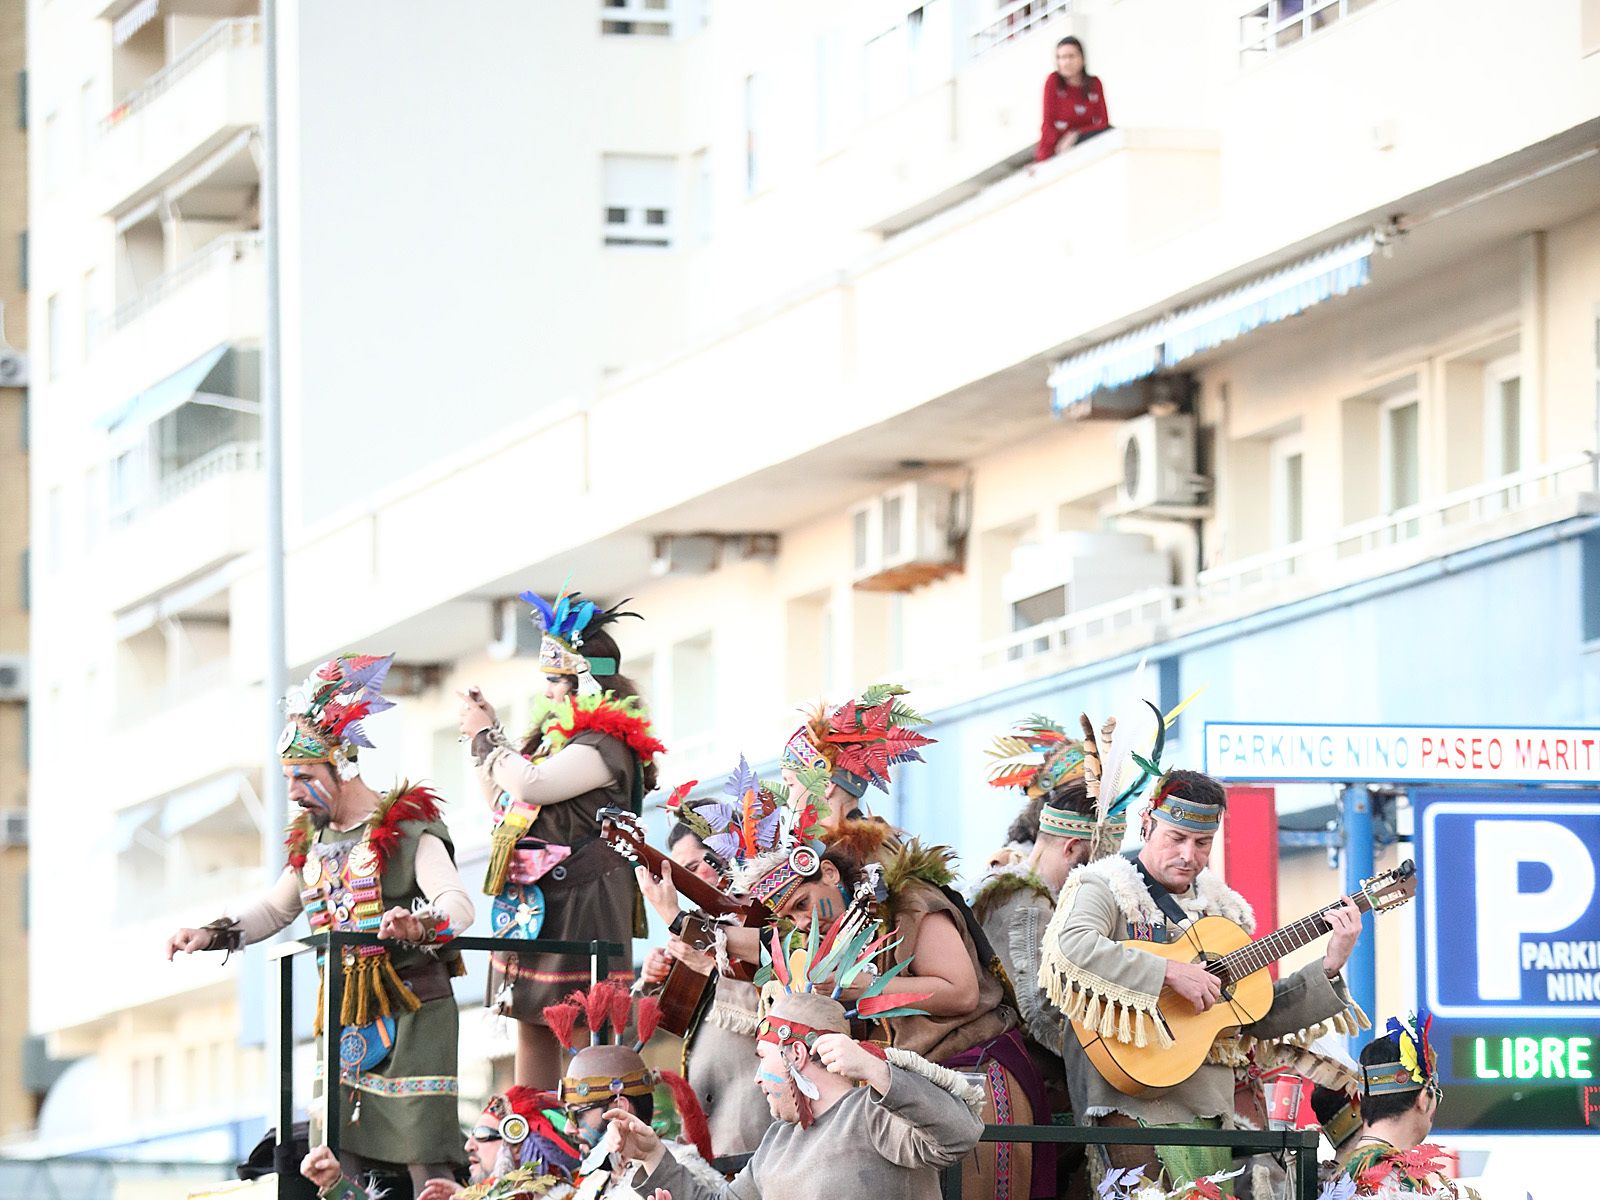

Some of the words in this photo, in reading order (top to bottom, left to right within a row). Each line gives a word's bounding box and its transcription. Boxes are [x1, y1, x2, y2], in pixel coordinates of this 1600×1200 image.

[1218, 734, 1333, 768] PARKING
[1346, 735, 1409, 769] NINO
[1421, 737, 1503, 770] PASEO
[1515, 738, 1600, 771] MARIT
[1474, 819, 1597, 1001] P
[1521, 940, 1600, 971] PARKI
[1475, 1036, 1593, 1079] LIBRE
